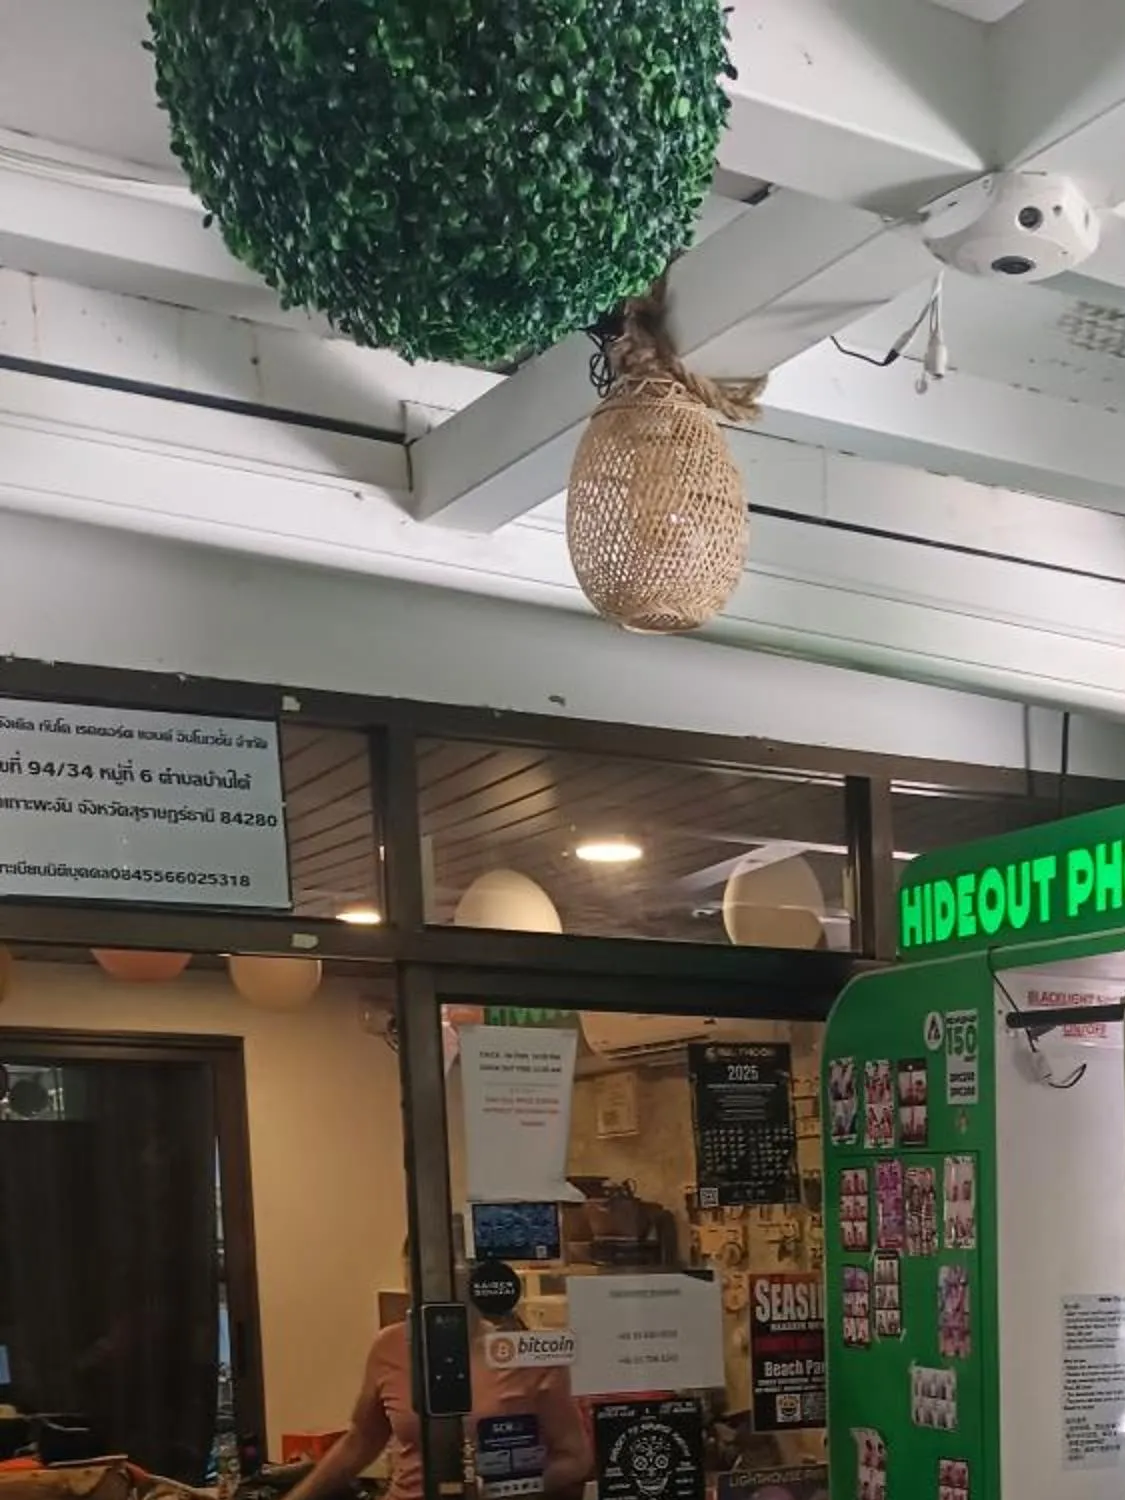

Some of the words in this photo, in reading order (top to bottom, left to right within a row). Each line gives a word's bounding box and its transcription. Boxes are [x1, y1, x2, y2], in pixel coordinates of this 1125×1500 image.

[27, 761, 94, 779] 94/34
[99, 759, 135, 785] หมู่ที่
[140, 769, 153, 783] 6
[220, 811, 278, 828] 84280
[901, 856, 1057, 947] HIDEOUT
[946, 1025, 977, 1055] 150
[727, 1065, 760, 1081] 2025
[518, 1336, 575, 1353] bitcoin
[763, 1360, 804, 1377] Beach
